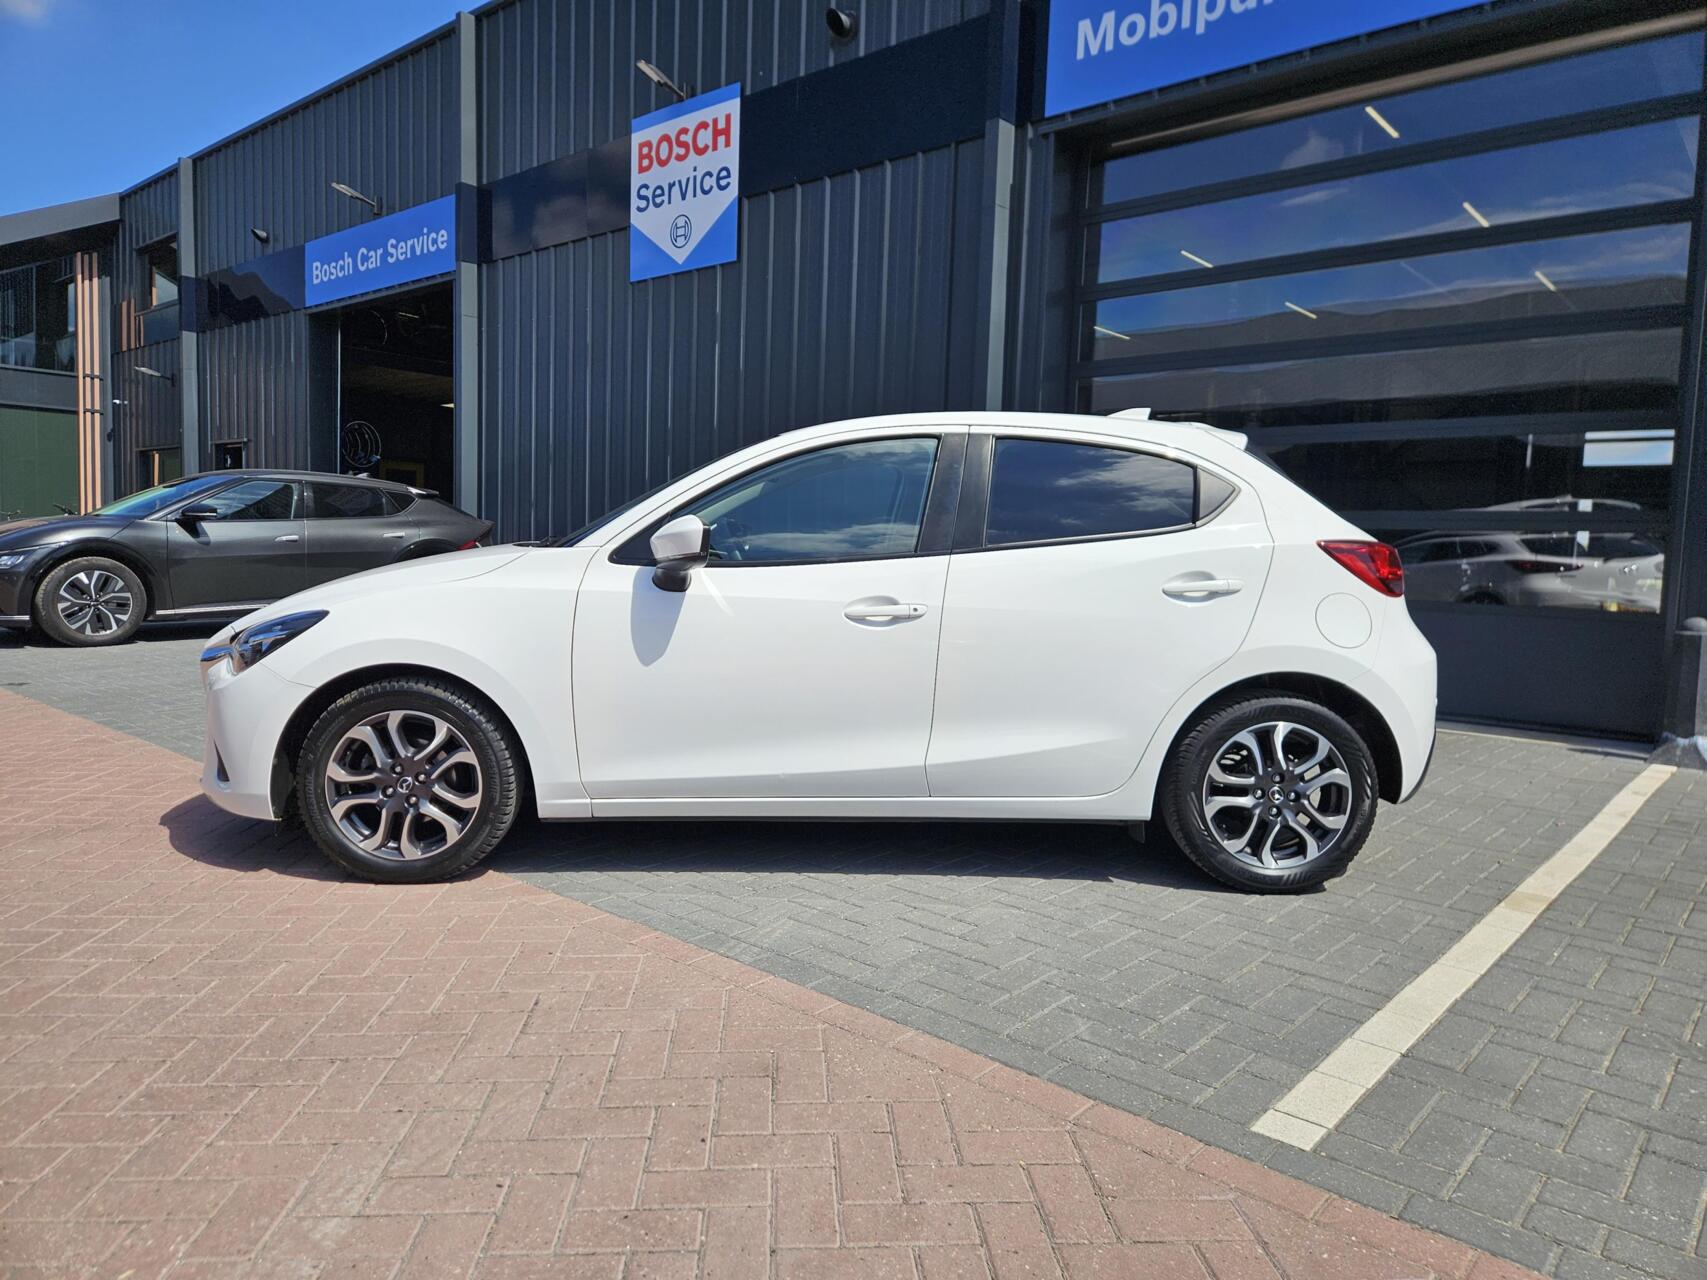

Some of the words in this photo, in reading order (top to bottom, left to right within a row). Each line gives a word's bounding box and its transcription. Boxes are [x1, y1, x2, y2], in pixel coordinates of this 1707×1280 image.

[1076, 0, 1276, 61] Mobip
[637, 112, 732, 175] BOSCH
[635, 165, 732, 213] Service
[312, 251, 353, 285] Bosch
[357, 247, 384, 272] Car
[387, 227, 448, 264] Service
